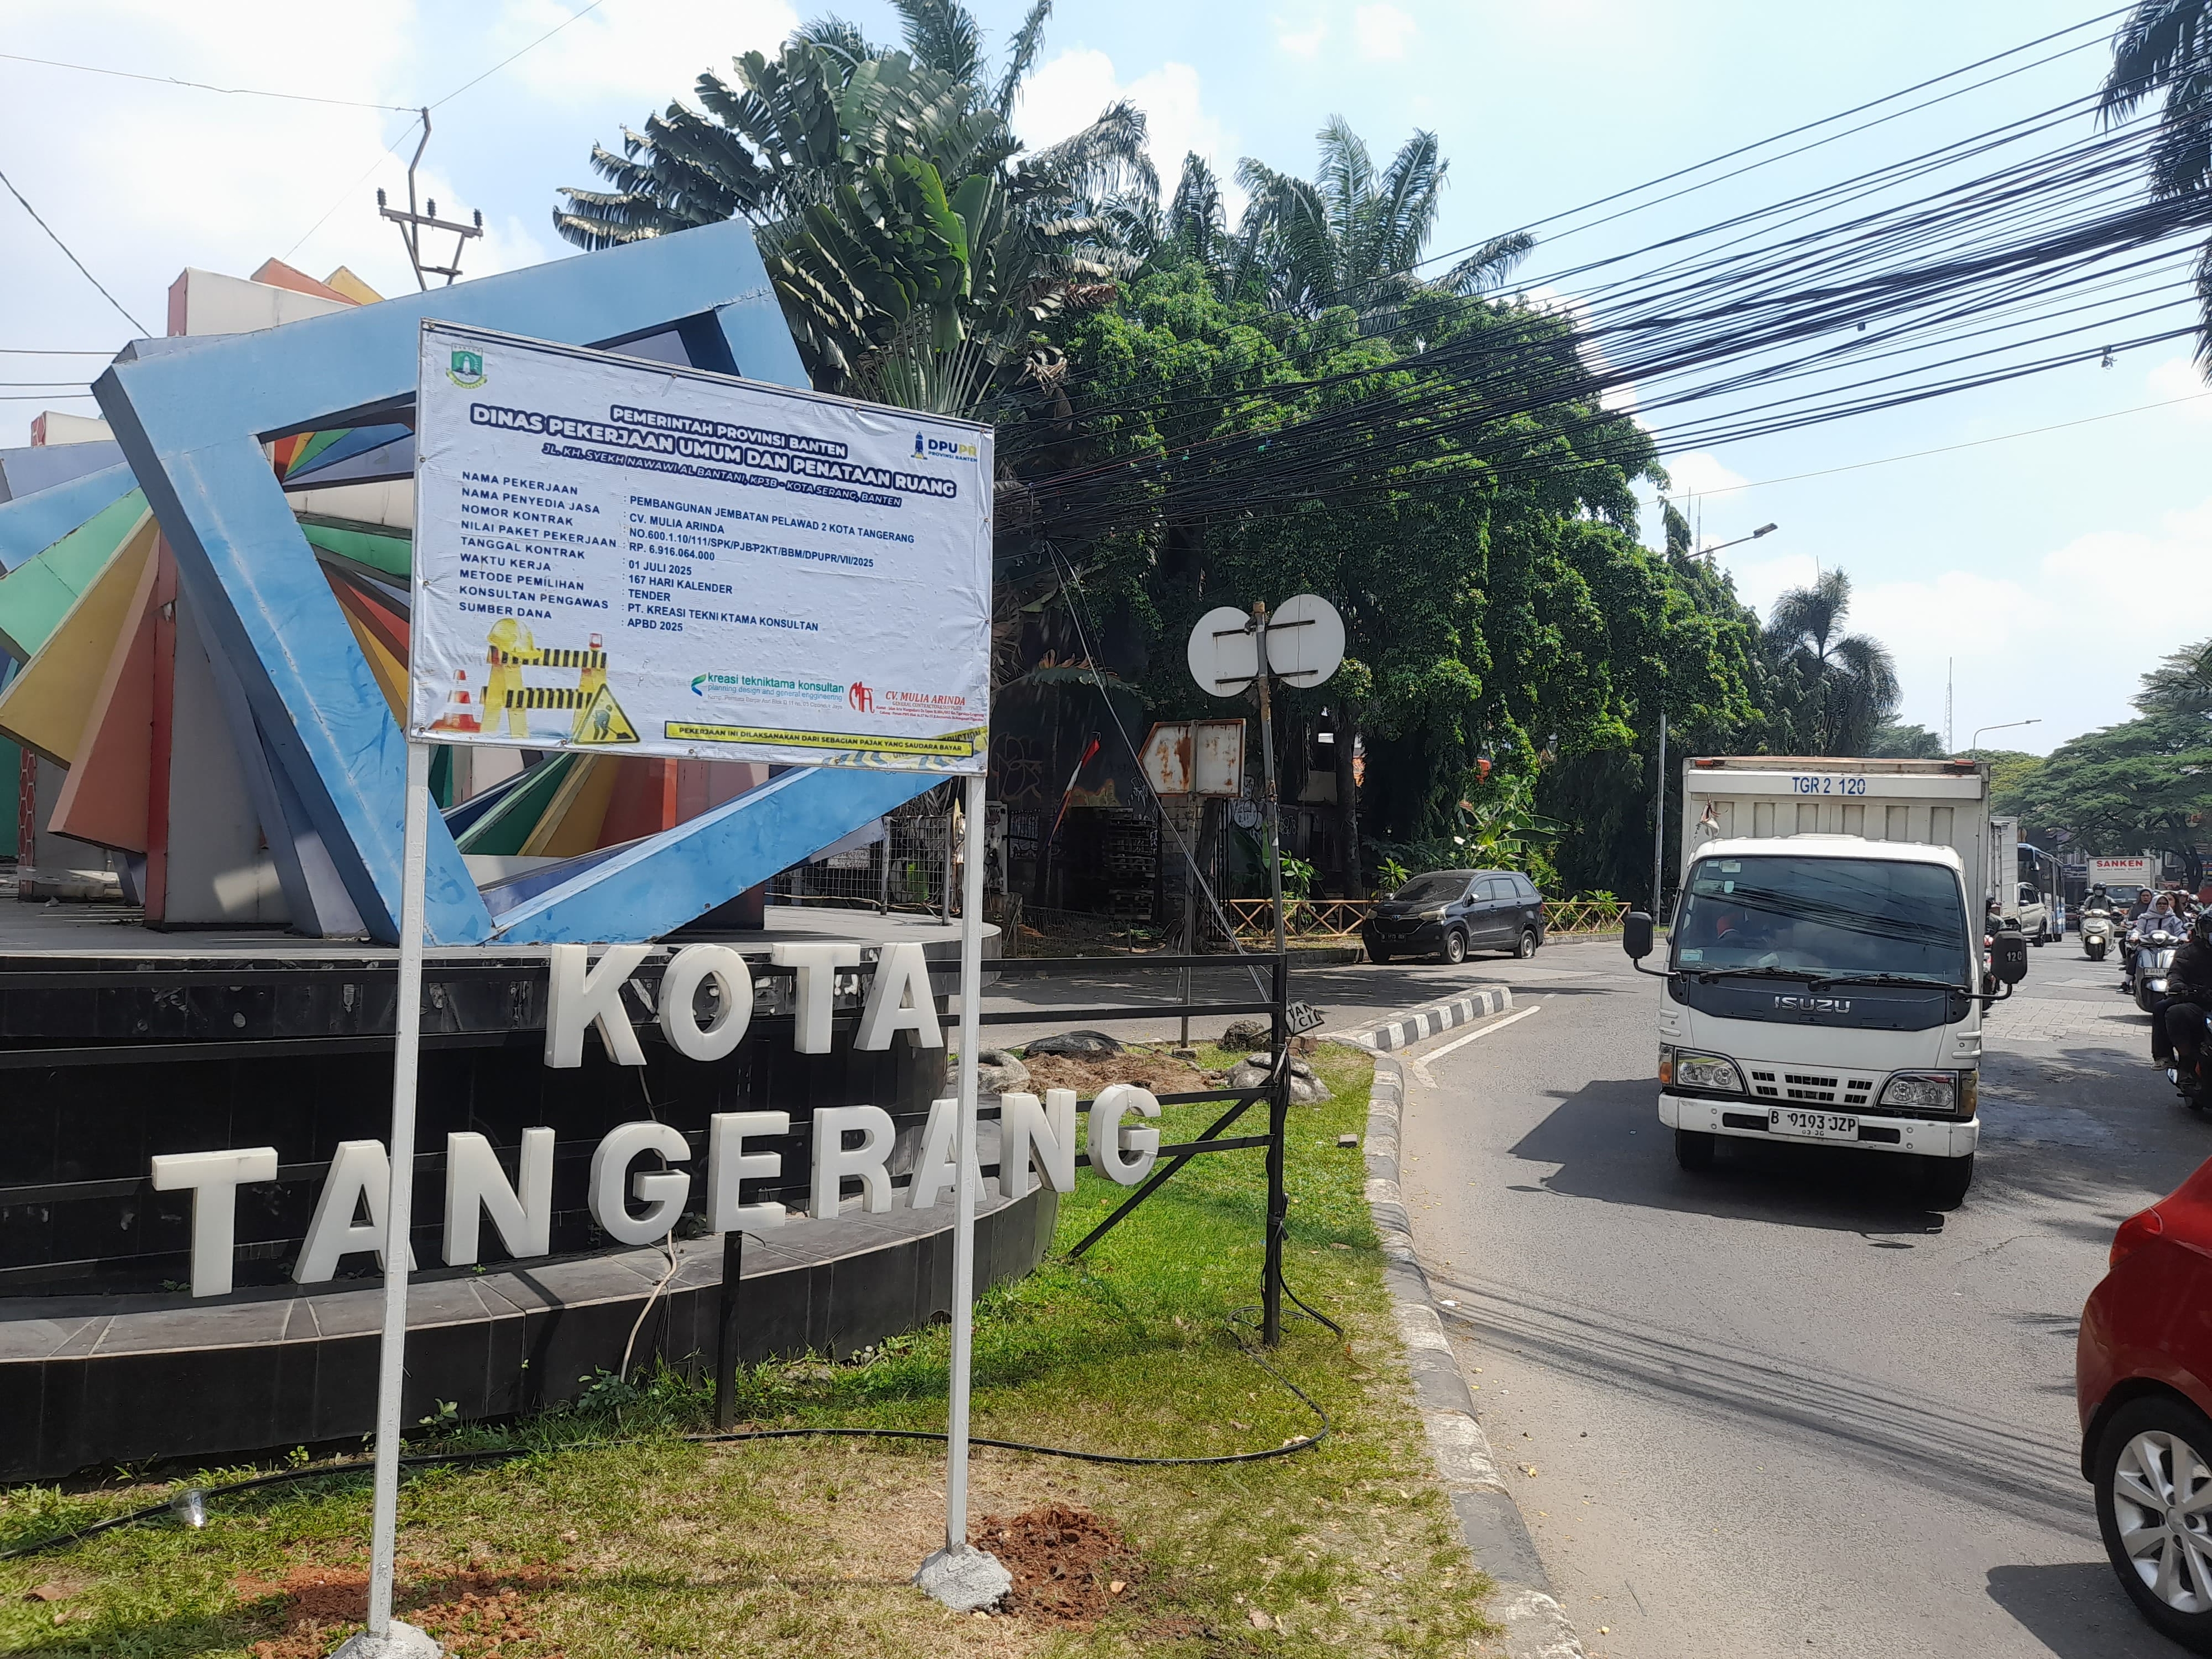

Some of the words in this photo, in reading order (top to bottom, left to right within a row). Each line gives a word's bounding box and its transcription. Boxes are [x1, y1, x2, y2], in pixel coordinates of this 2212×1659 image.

[612, 407, 714, 435] PEMERINTAH
[717, 425, 785, 447] PROVINSI
[789, 437, 846, 457] BANTEN
[928, 438, 977, 456] DPUPR
[473, 406, 543, 431] DINAS
[549, 418, 673, 452] PEKERJAAN
[679, 439, 741, 463] UMUM
[747, 450, 787, 470] DAN
[793, 458, 890, 486] PENATAAN
[895, 474, 955, 496] RUANG
[928, 450, 954, 459] PROVINSI
[543, 444, 560, 454] JL.
[563, 448, 584, 458] KH.
[586, 451, 624, 464] SYEKH
[627, 457, 678, 472] NAWAWI
[679, 465, 695, 475] AL
[697, 467, 747, 484] BANTANI,
[750, 475, 778, 487] KP3B
[786, 482, 815, 493] KOTA
[816, 486, 859, 501] SERANG,
[861, 493, 902, 506] BANTEN
[461, 487, 499, 501] NAMA
[502, 493, 565, 509] PENYEDIA
[569, 502, 600, 514] JASA
[629, 513, 647, 524] CV.
[649, 516, 683, 529] MULIA
[685, 520, 725, 535] ARINDA
[461, 504, 509, 518] NOMOR
[513, 510, 573, 527] KONTRAK
[462, 471, 499, 484] NAMA
[503, 476, 578, 495] PEKERJAAN
[630, 495, 712, 515] PEMBANGUNAN
[714, 507, 769, 524] JEMBATAN
[771, 515, 819, 530] PELAWAD
[821, 522, 827, 532] 2
[829, 524, 855, 536] KOTA
[857, 527, 915, 544] TANGERANG
[460, 536, 521, 551] TANGGAL
[525, 543, 585, 559] KONTRAK
[628, 559, 640, 569] 01
[642, 561, 666, 573] JULI
[668, 564, 692, 575] 2025
[461, 520, 494, 532] NILAI
[498, 524, 540, 537] PAKET
[543, 530, 616, 548] PEKERJAAN
[628, 541, 647, 553] RP.
[649, 544, 715, 561] 6.916.064.000
[460, 552, 506, 566] WAKTU
[510, 558, 551, 571] KERJA
[628, 574, 646, 585] 167
[649, 576, 675, 588] HARI
[676, 579, 733, 594] KALENDER
[460, 569, 512, 584] METODE
[517, 575, 584, 591] PEMILIHAN
[628, 588, 671, 602] TENDER
[459, 585, 536, 601] KONSULTAN
[540, 593, 609, 609] PENGAWAS
[627, 603, 644, 613] PT.
[646, 604, 686, 618] KREASI
[759, 616, 819, 632] KONSULTAN
[459, 601, 513, 616] SUMBER
[517, 607, 552, 619] DANA
[627, 618, 657, 629] APBD
[659, 621, 684, 632] 2025
[707, 672, 739, 684] kreasi
[741, 675, 796, 690] tekniktama
[797, 679, 844, 694] konsultan
[707, 683, 737, 694] planning
[738, 685, 761, 695] design
[762, 687, 775, 695] and
[776, 690, 800, 698] general
[885, 690, 899, 701] CV.
[900, 691, 929, 703] MULIA
[931, 694, 966, 706] ARINDA
[679, 727, 726, 737] PEKERJAAN
[740, 730, 800, 741] DILAKSANAKAN
[859, 738, 884, 747] PAJAK
[904, 742, 938, 750] SAUDARA
[939, 744, 963, 752] BAYAR
[1791, 777, 1820, 794] TGR
[1823, 778, 1831, 794] 2
[1838, 778, 1866, 795] 120
[2096, 859, 2143, 868] SANKEN
[2006, 950, 2022, 961] 120
[543, 942, 945, 1069] KOTA
[1773, 996, 1851, 1014] ISUZU
[1770, 1110, 1779, 1124] B
[1789, 1112, 1825, 1130] 9193
[1828, 1116, 1856, 1132] JZP
[150, 1083, 1162, 1298] TANGERANG
